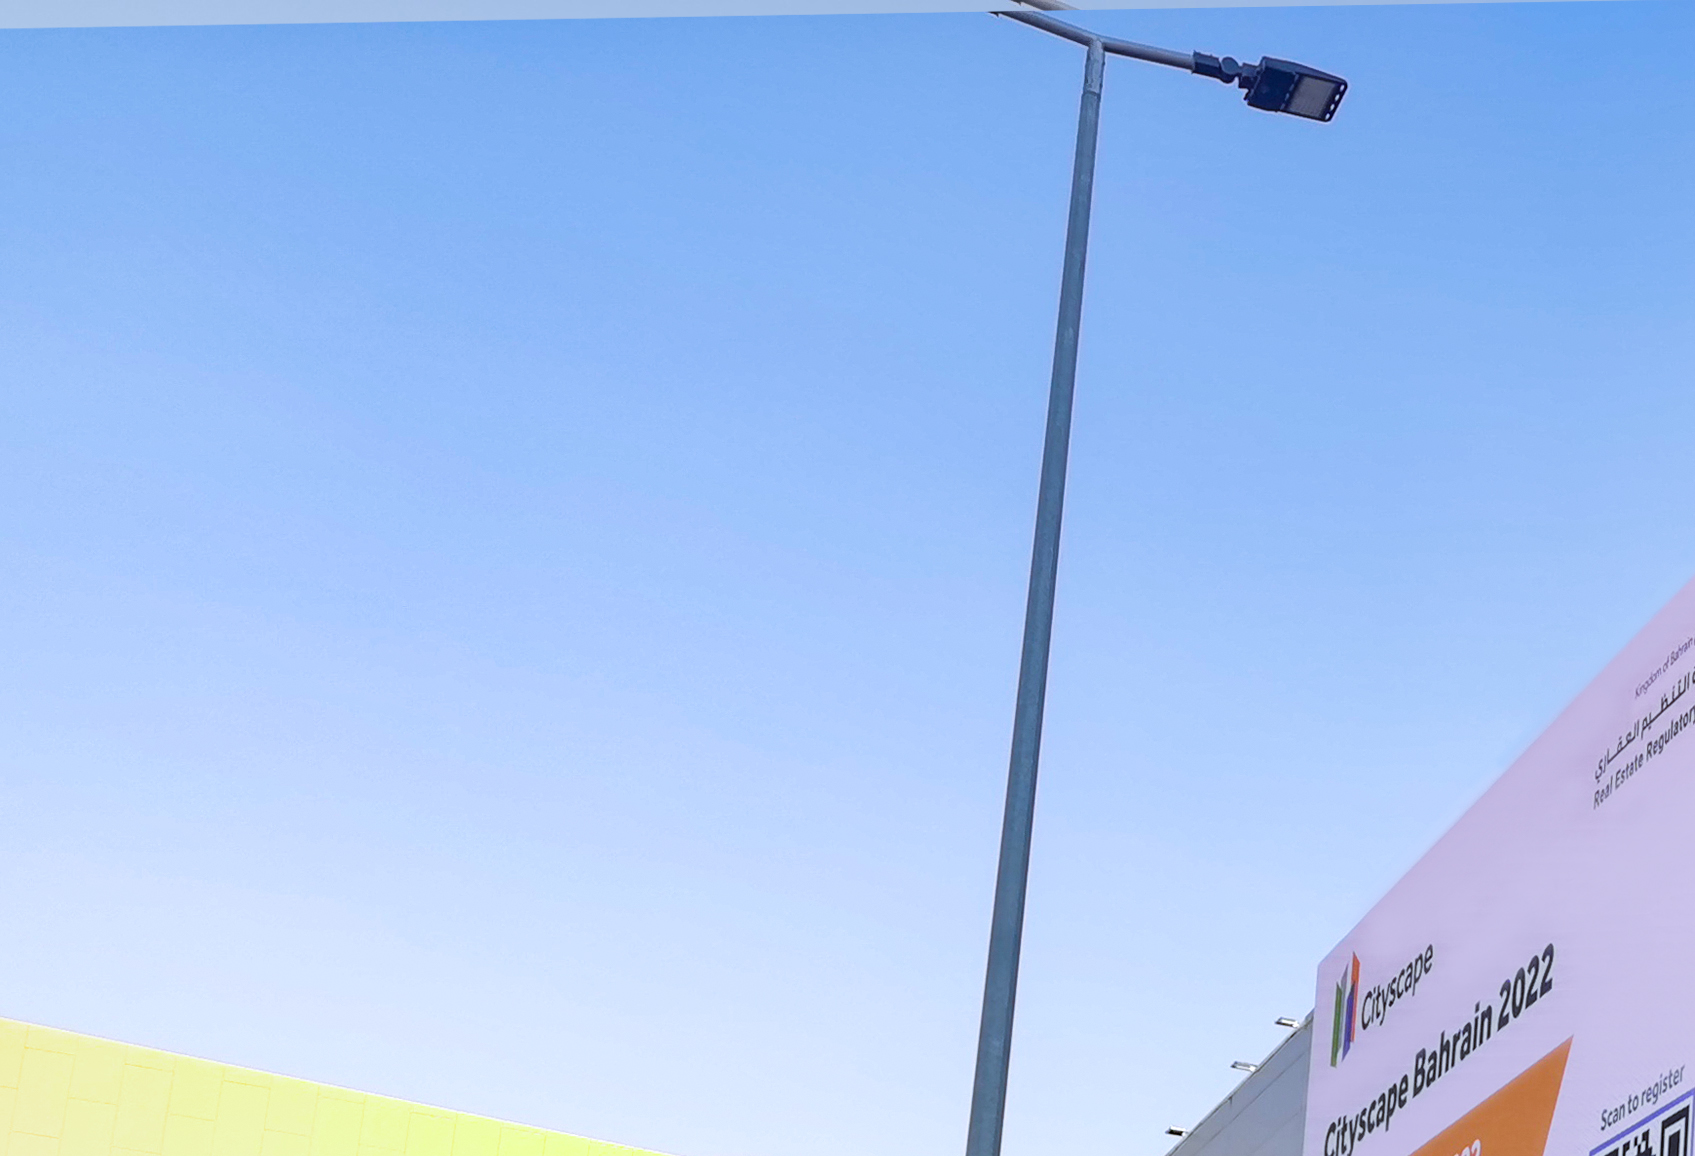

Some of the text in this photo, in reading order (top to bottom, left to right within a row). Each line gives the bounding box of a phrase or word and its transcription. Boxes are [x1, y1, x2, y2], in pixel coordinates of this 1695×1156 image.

[1641, 671, 1690, 740] التنظيم
[1593, 775, 1614, 810] Real
[1615, 753, 1644, 790] Estate
[1594, 719, 1640, 785] العقاري
[1361, 943, 1434, 1031] Cityscape
[1413, 1000, 1493, 1099] Bahrain
[1497, 942, 1554, 1032] 2022
[1600, 1064, 1686, 1131] Scan to register
